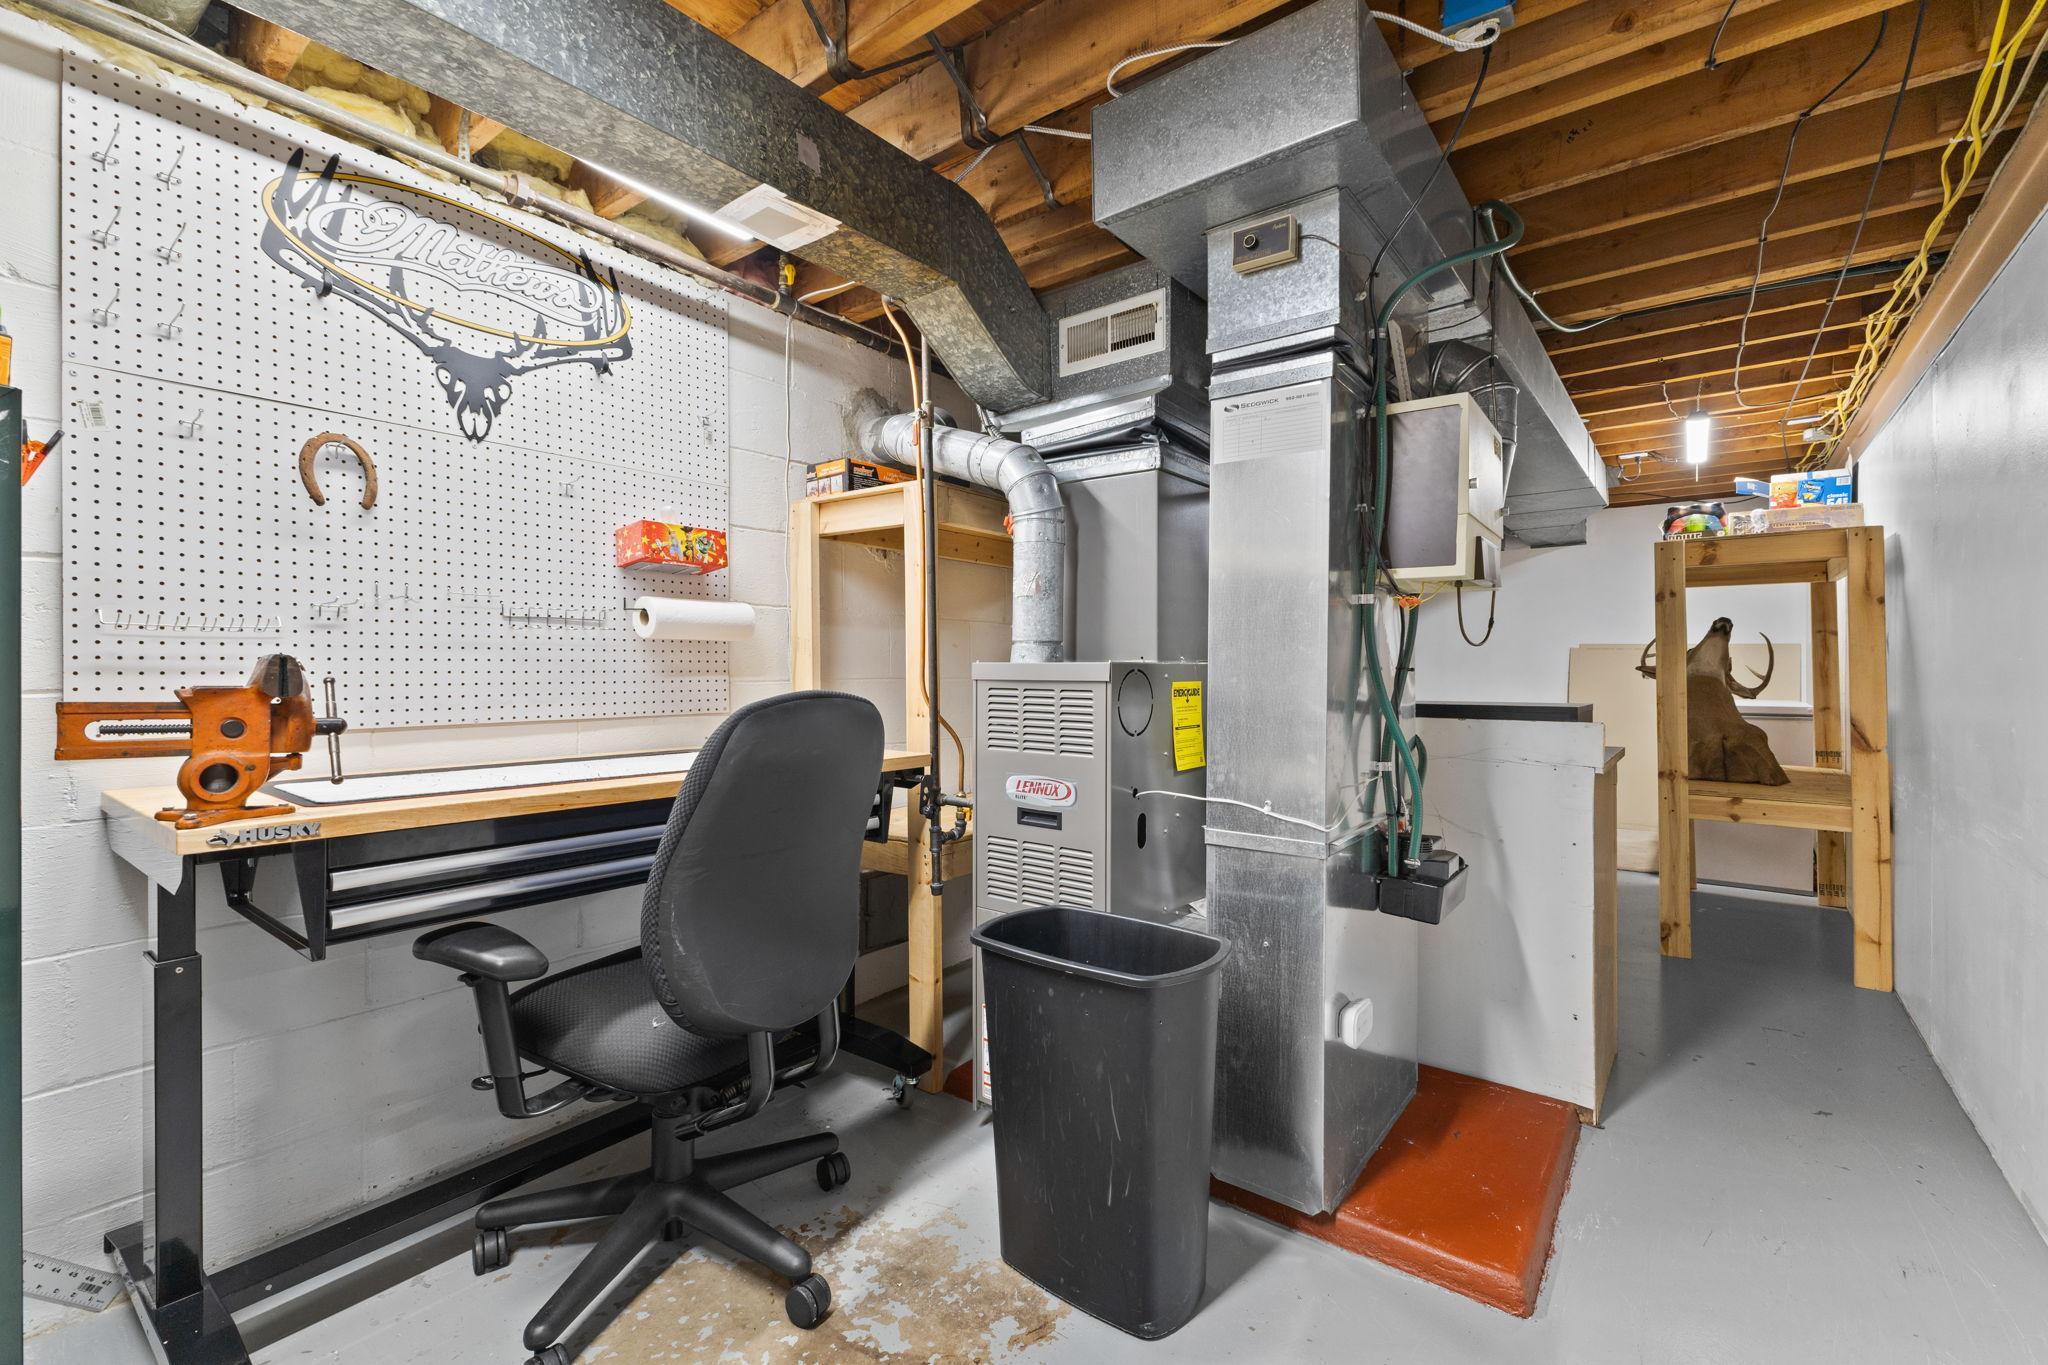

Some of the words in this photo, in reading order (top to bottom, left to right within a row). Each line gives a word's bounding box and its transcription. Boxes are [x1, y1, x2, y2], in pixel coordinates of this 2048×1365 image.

[1240, 398, 1279, 409] SEDGWICK
[1015, 779, 1061, 798] LENNOX
[239, 822, 321, 843] HUSKY
